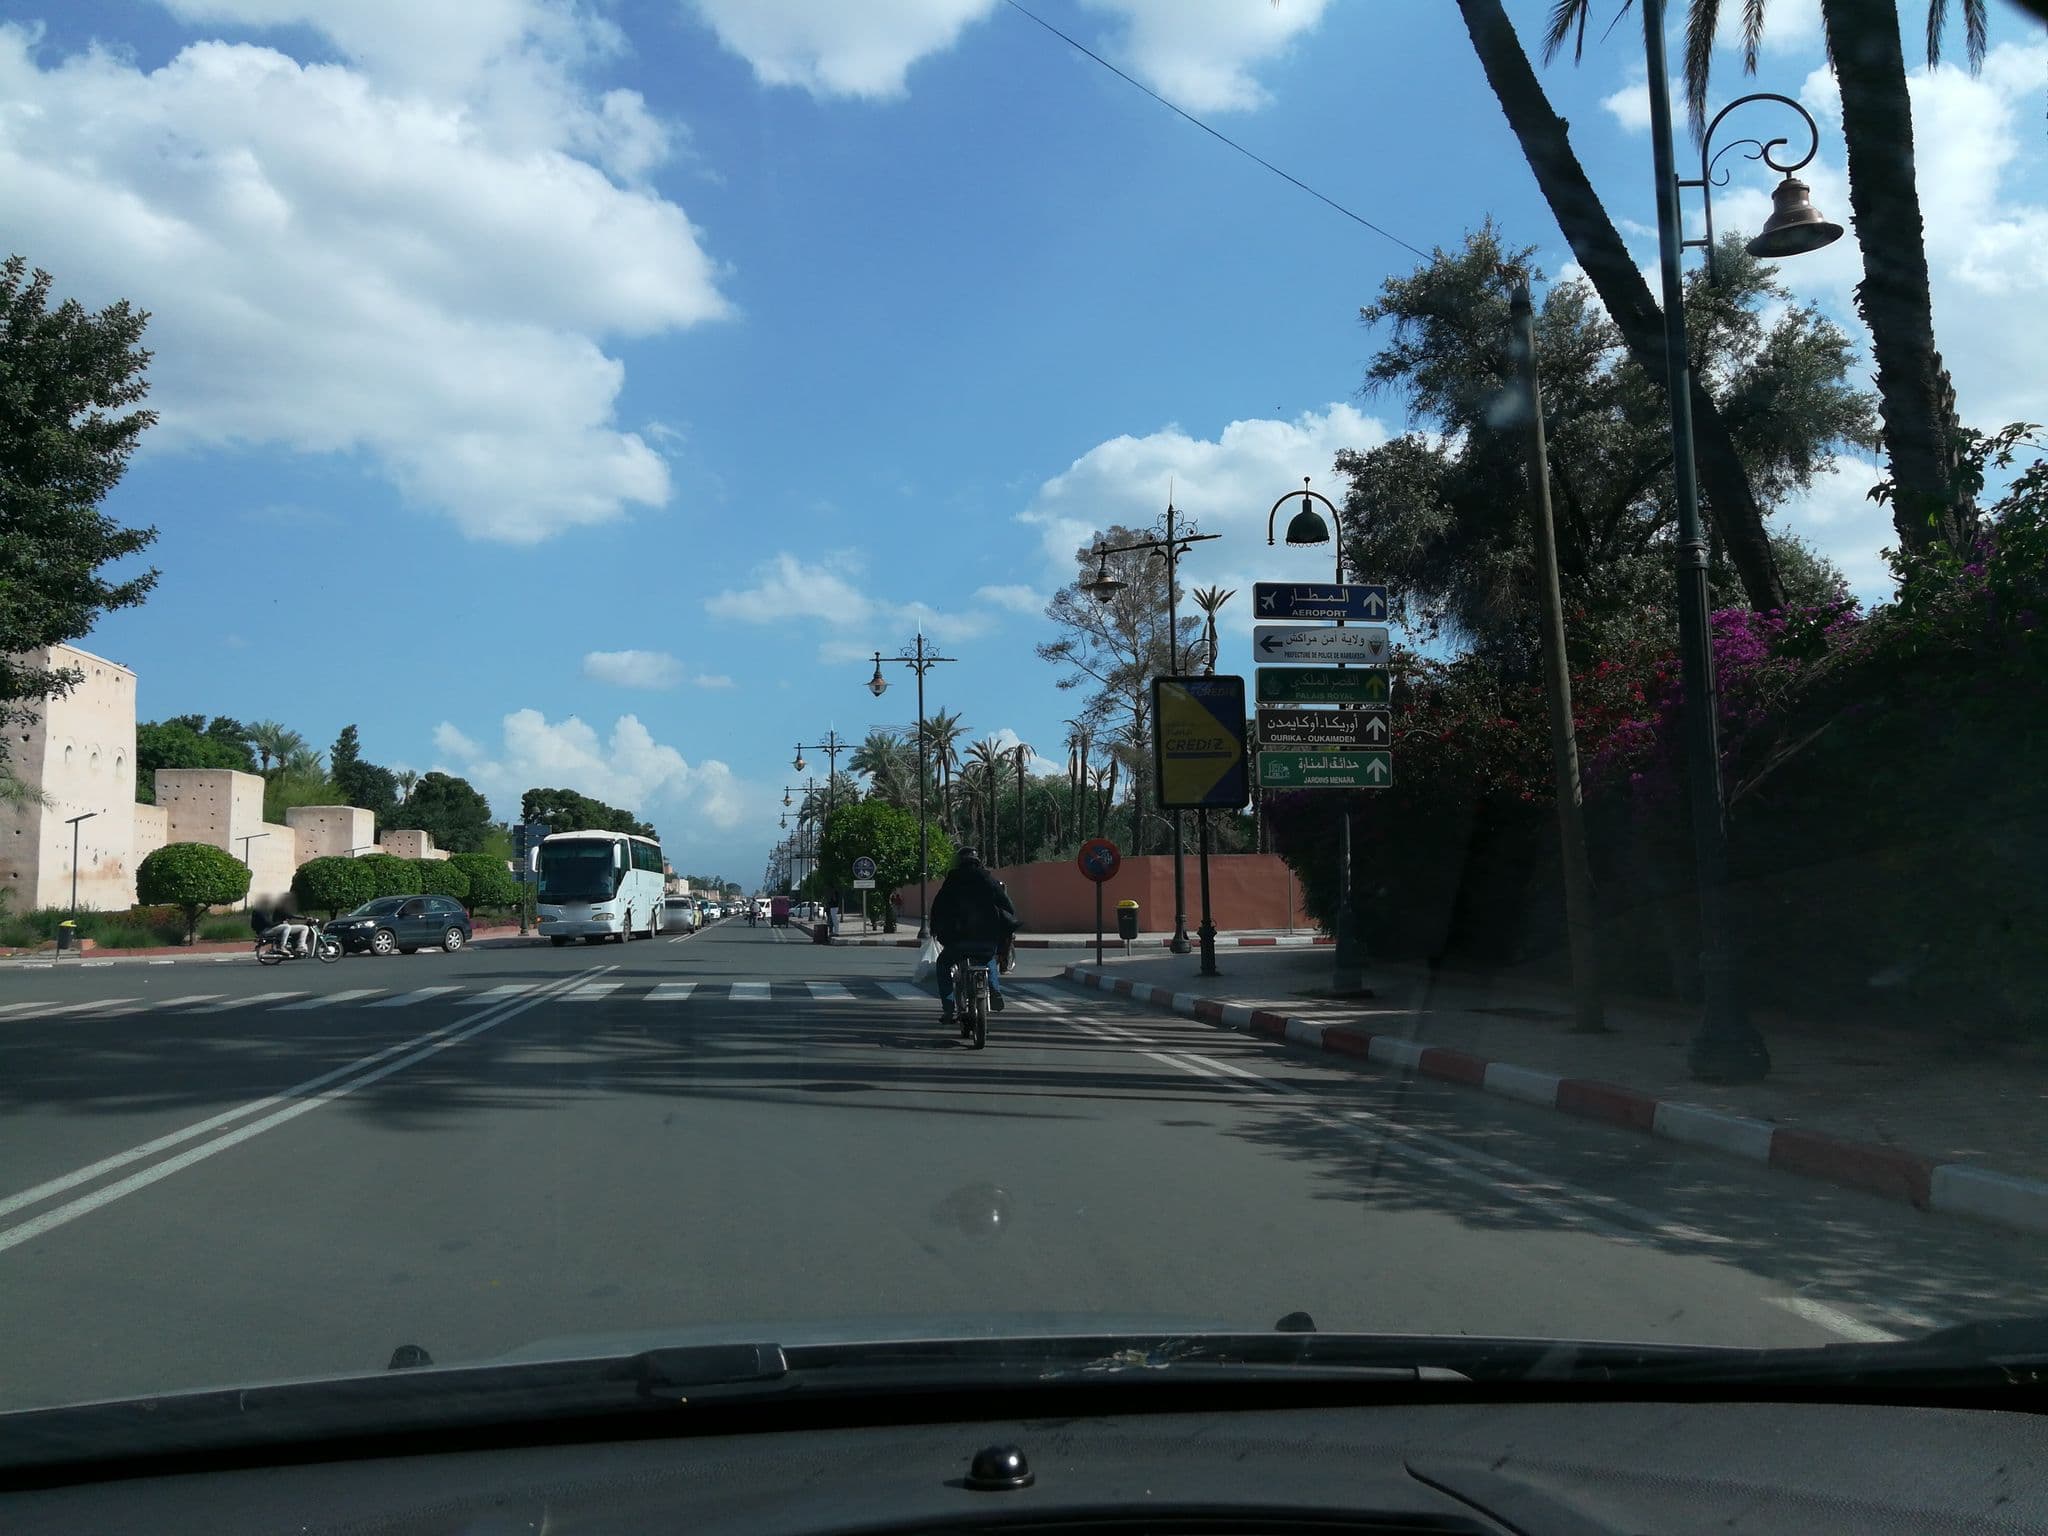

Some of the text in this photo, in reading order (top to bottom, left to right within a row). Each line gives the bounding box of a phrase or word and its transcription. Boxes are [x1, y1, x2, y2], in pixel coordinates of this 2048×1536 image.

[1289, 588, 1349, 606] المطار
[1292, 609, 1348, 617] AEROPORT
[1286, 632, 1317, 646] مراكش
[1341, 632, 1365, 647] ولاية
[1295, 692, 1325, 700] PALAIS
[1270, 734, 1301, 742] OURIKA
[1307, 735, 1356, 743] OUKAIMDEN
[1298, 756, 1360, 773] حدائق المنارة
